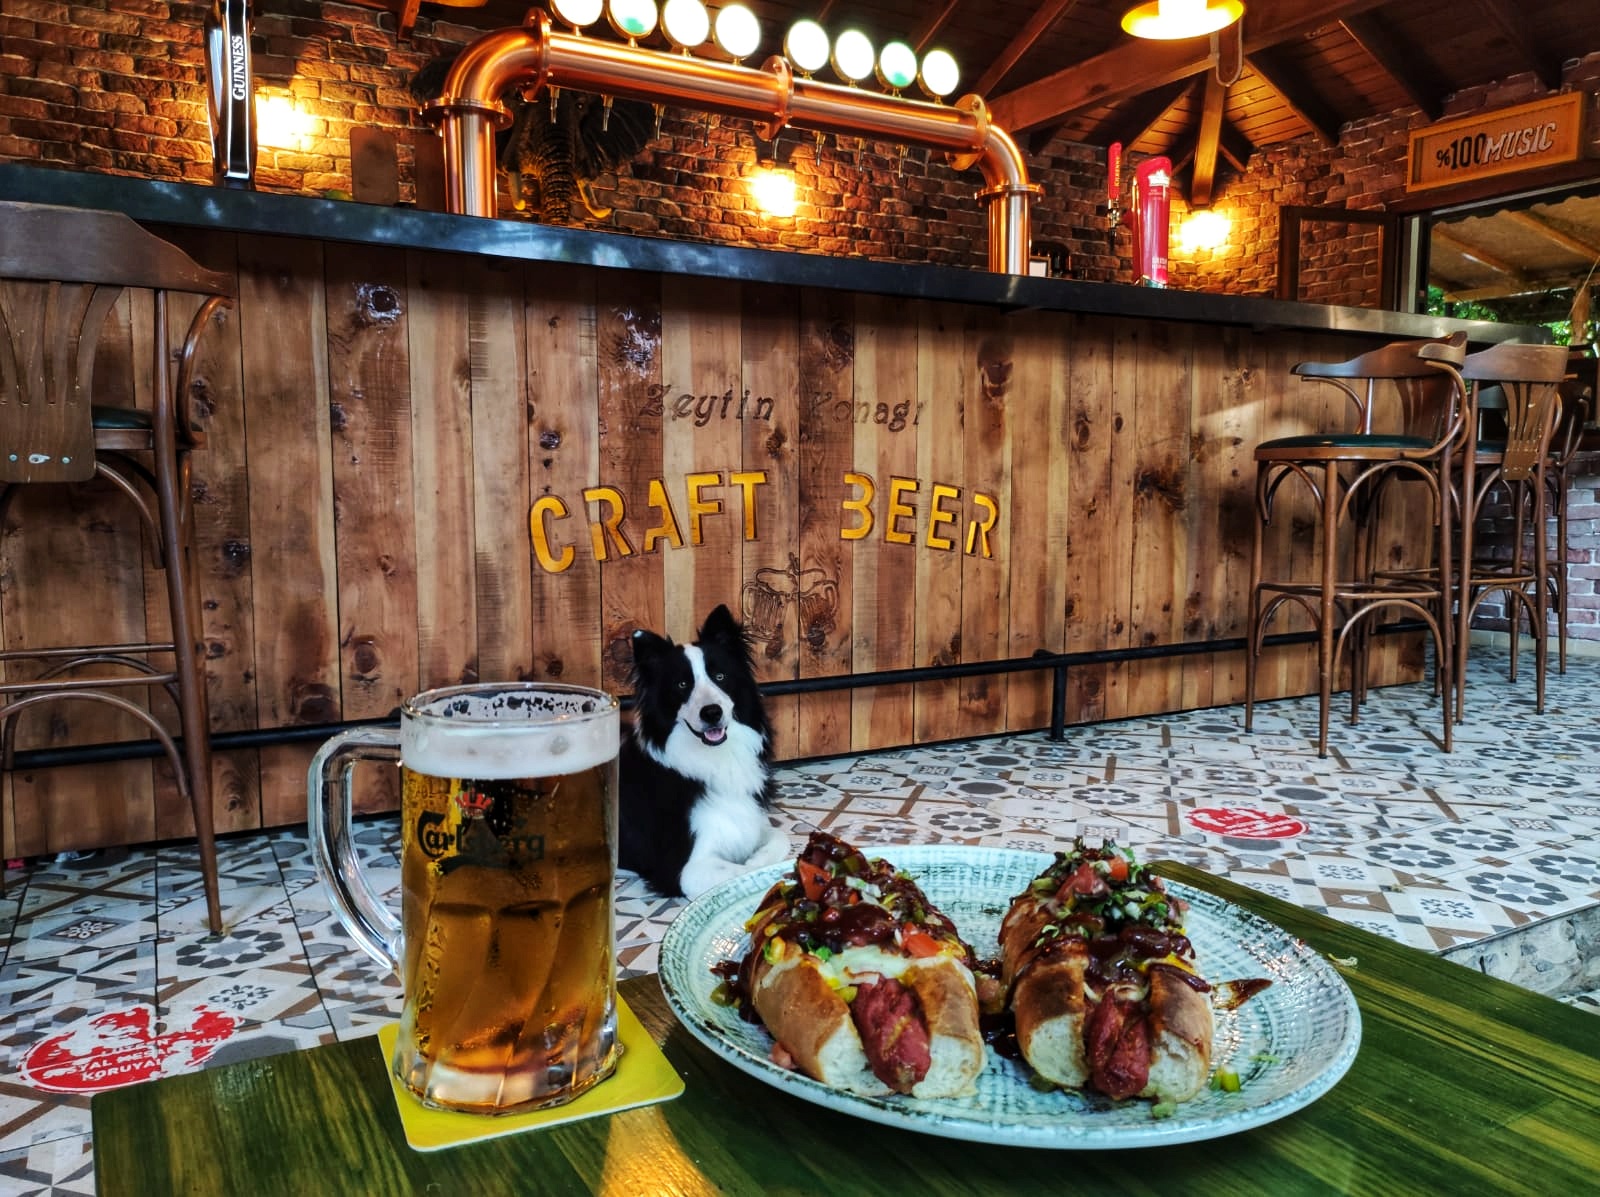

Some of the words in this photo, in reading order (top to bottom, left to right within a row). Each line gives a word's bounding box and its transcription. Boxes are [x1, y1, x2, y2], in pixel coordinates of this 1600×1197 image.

[231, 35, 247, 101] GUINNESS
[639, 383, 775, 428] Zeytin
[529, 469, 770, 574] CRAFT
[839, 471, 1001, 560] BEER
[416, 809, 545, 861] Carlerg
